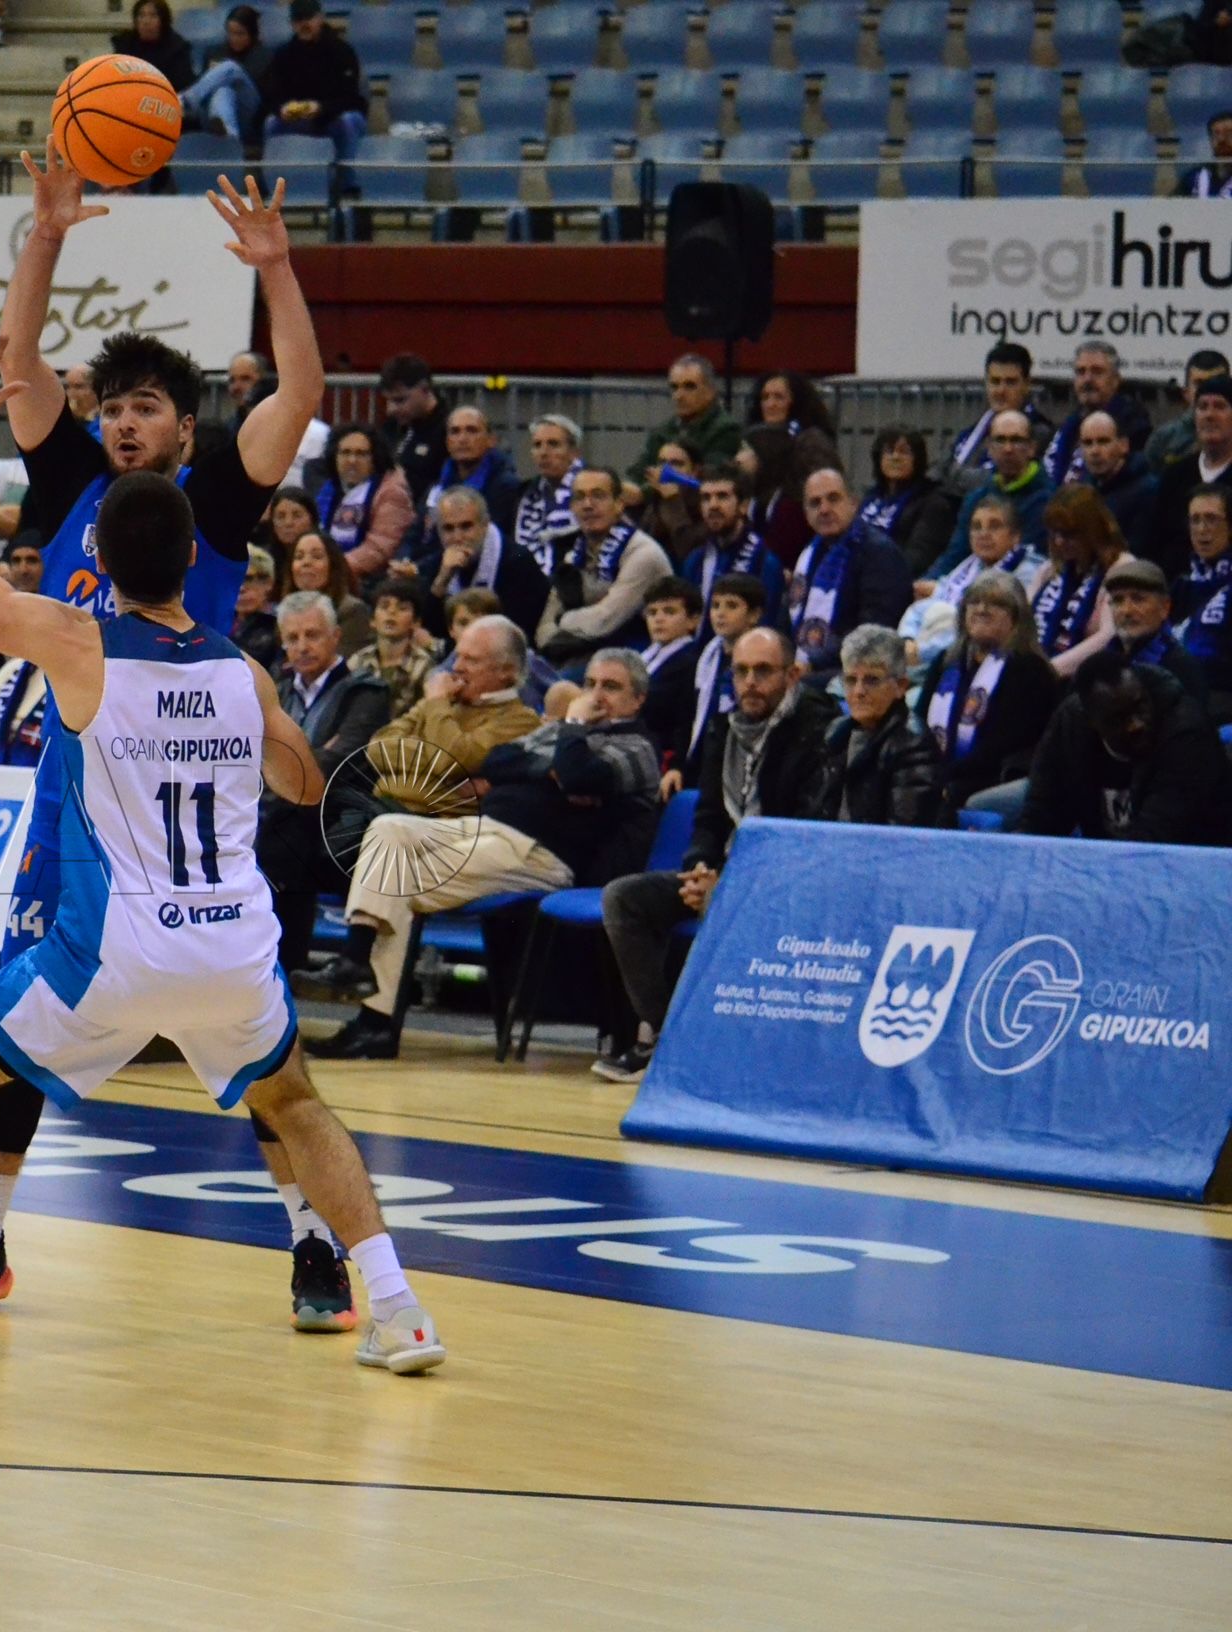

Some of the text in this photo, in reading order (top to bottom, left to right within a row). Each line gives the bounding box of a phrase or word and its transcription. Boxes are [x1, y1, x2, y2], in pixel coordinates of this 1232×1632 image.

[952, 302, 1231, 346] inguruzaintza
[157, 690, 216, 719] MAIZA
[111, 736, 253, 762] ORAINGIPUZKOA
[155, 782, 224, 887] 11
[188, 903, 243, 924] Irizar
[777, 935, 872, 958] Gipuzkoako
[748, 957, 862, 984] Foru Aldundia
[1090, 980, 1171, 1013] ORAIN
[1079, 1013, 1210, 1050] GIPUZKOA
